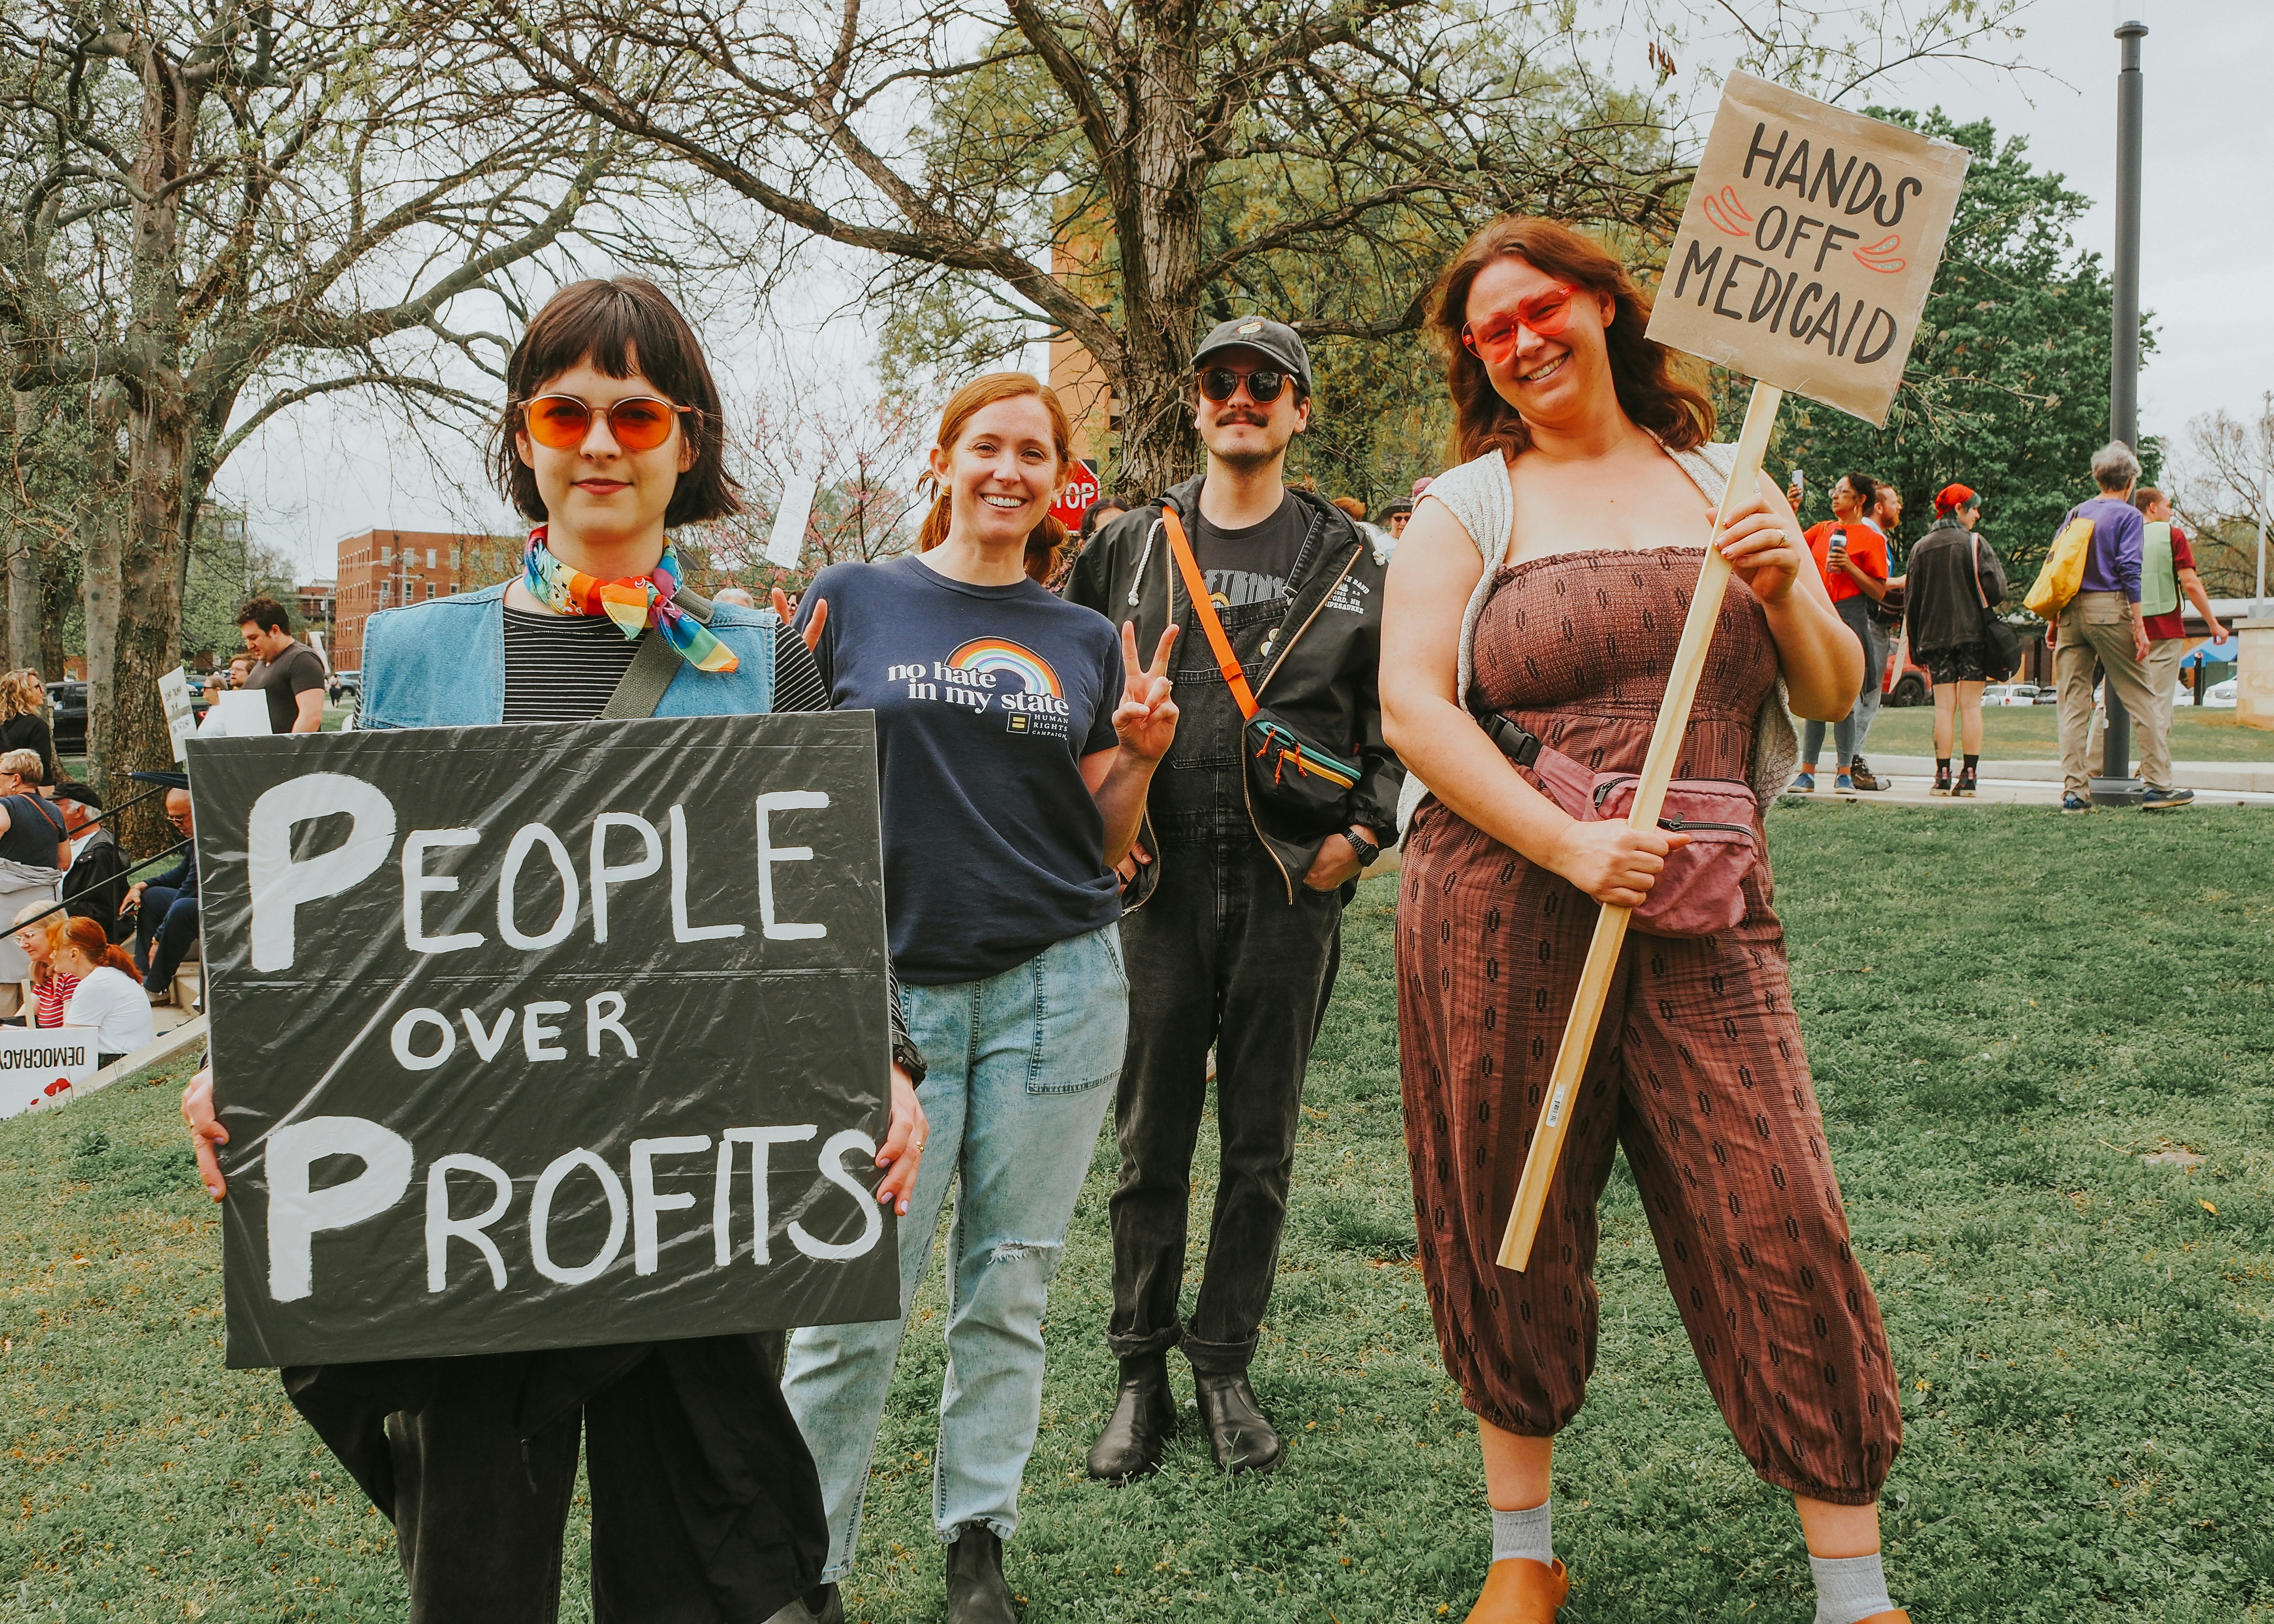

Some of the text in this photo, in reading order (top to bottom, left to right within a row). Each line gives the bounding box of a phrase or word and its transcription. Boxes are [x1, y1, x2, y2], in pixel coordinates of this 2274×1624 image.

[1742, 122, 1922, 227] HANDS
[1755, 205, 1860, 273] OFF
[1674, 239, 1897, 364] MEDICAID
[1350, 598, 1361, 607] NH
[1352, 578, 1370, 594] BAND
[886, 661, 997, 688] no hate
[907, 678, 1070, 717] in my state
[1033, 722, 1068, 732] RIGHTS
[1034, 714, 1068, 724] HUMAN
[248, 771, 833, 973] PEOPLE
[390, 990, 639, 1071] OVER
[264, 1116, 884, 1304] PROFITS
